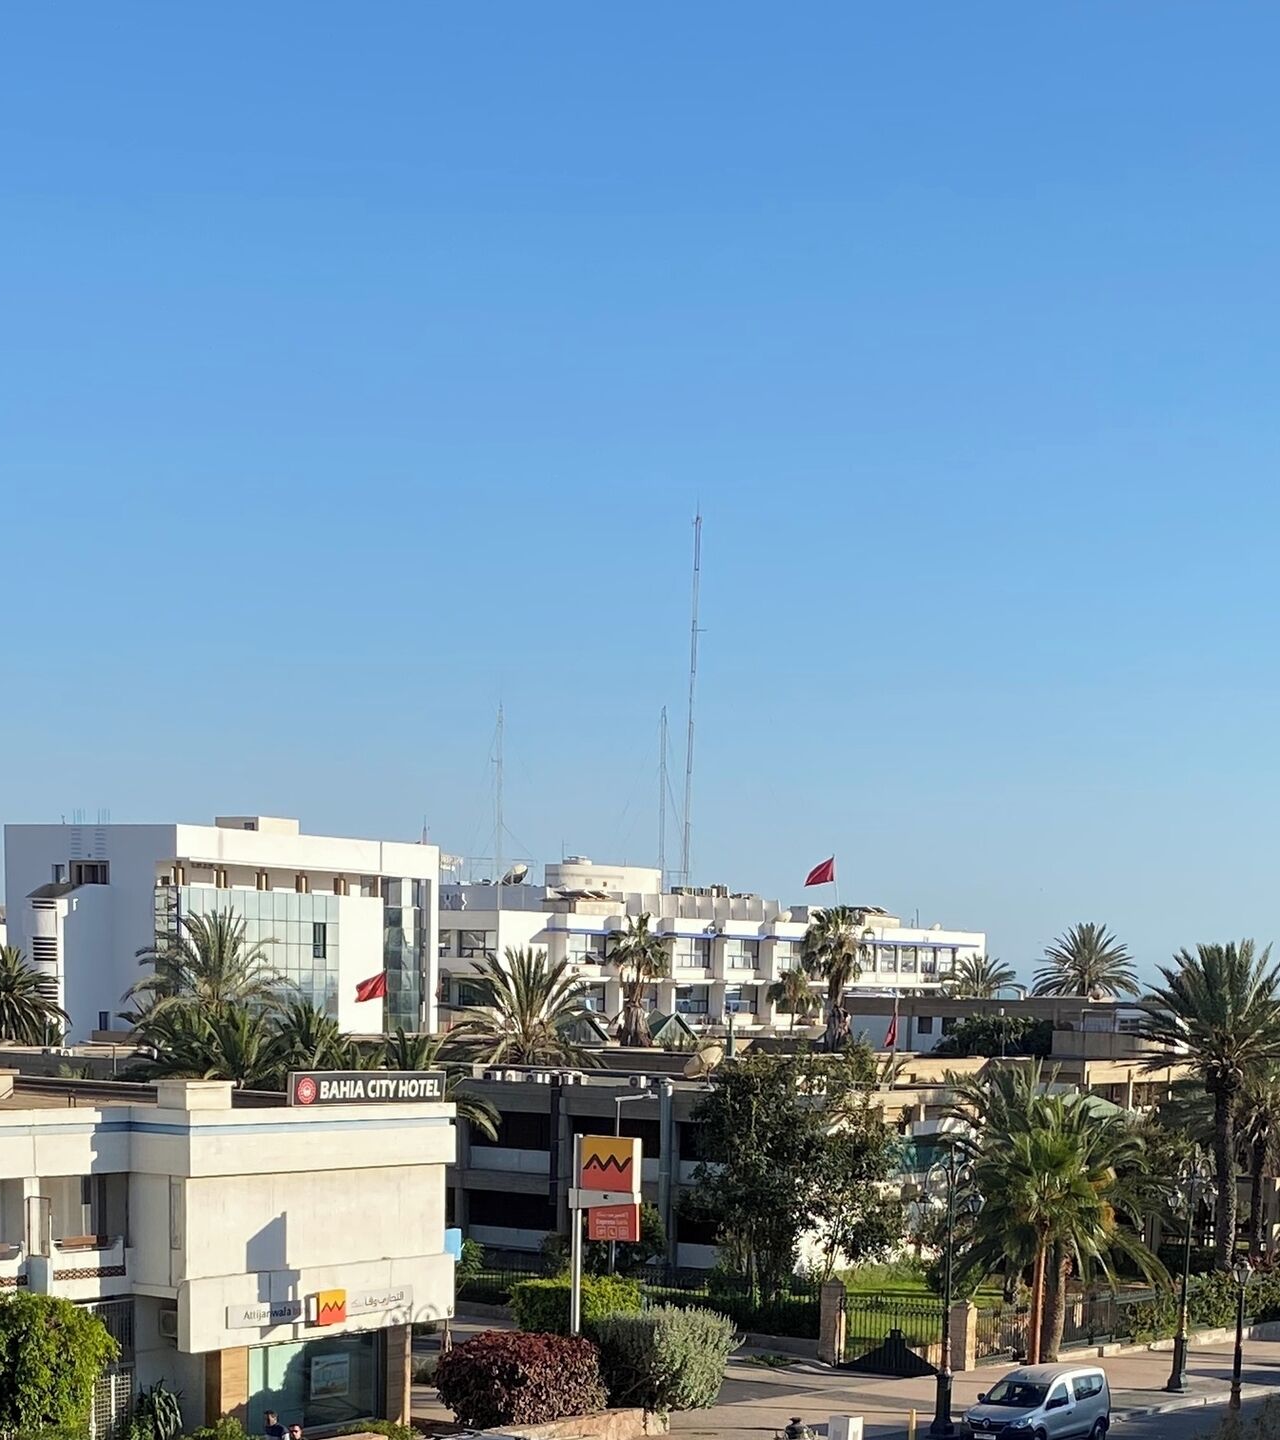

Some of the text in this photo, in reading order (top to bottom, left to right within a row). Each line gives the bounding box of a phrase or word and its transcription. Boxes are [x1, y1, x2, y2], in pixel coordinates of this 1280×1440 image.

[320, 1079, 440, 1099] BAHIA CITY HOTEL
